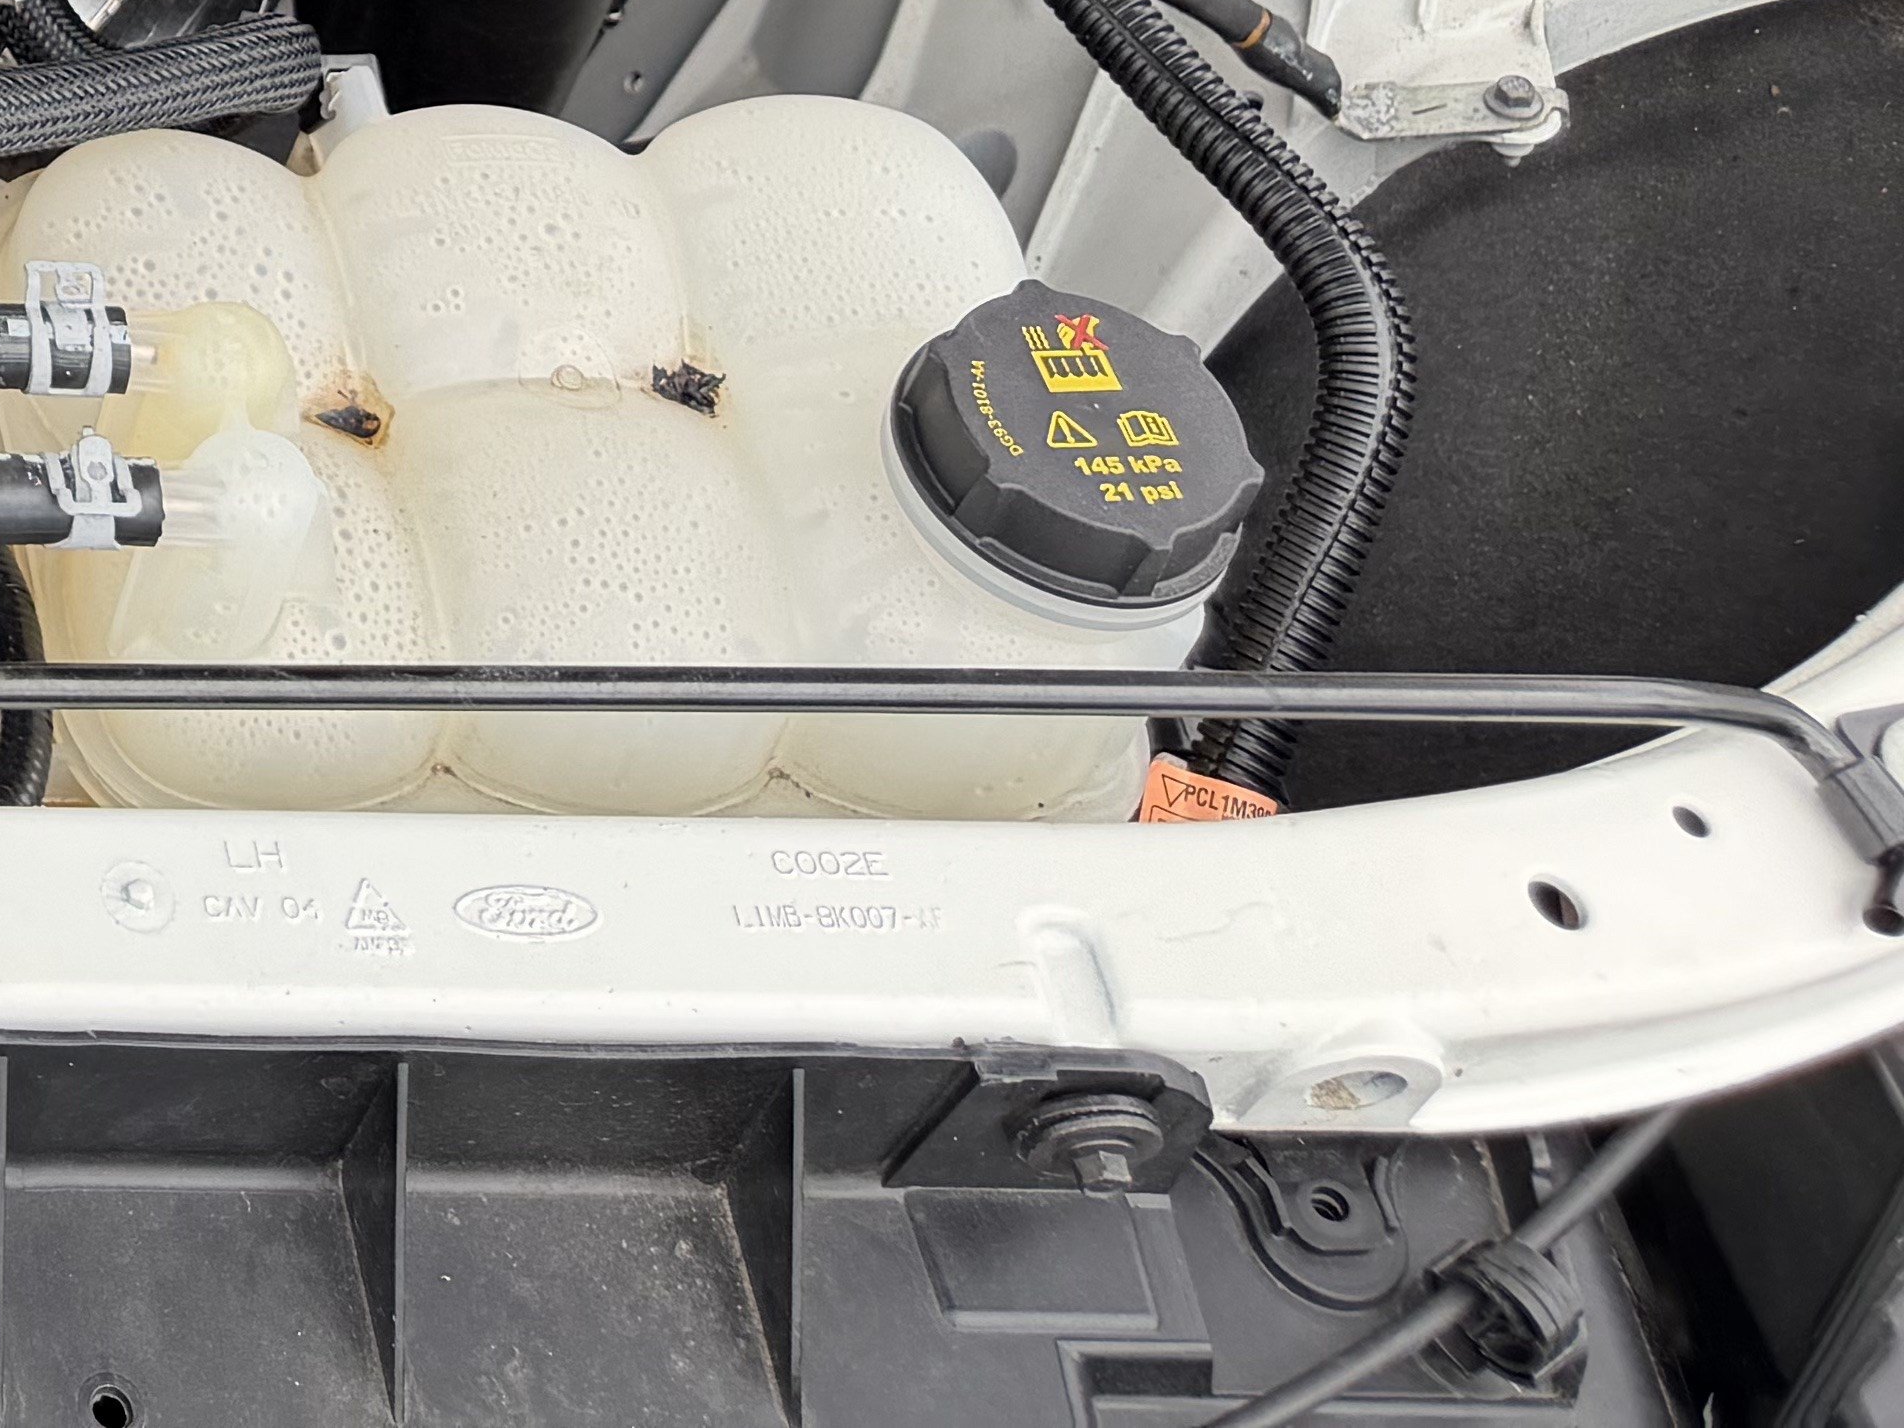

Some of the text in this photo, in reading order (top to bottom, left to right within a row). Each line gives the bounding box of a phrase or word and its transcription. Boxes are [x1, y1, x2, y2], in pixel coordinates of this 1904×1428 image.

[1074, 454, 1183, 477] 145 kPa
[1099, 480, 1185, 505] 21 psi
[223, 840, 285, 870] LH
[771, 850, 890, 877] C002E
[202, 894, 263, 920] CAV
[476, 889, 580, 933] Ford
